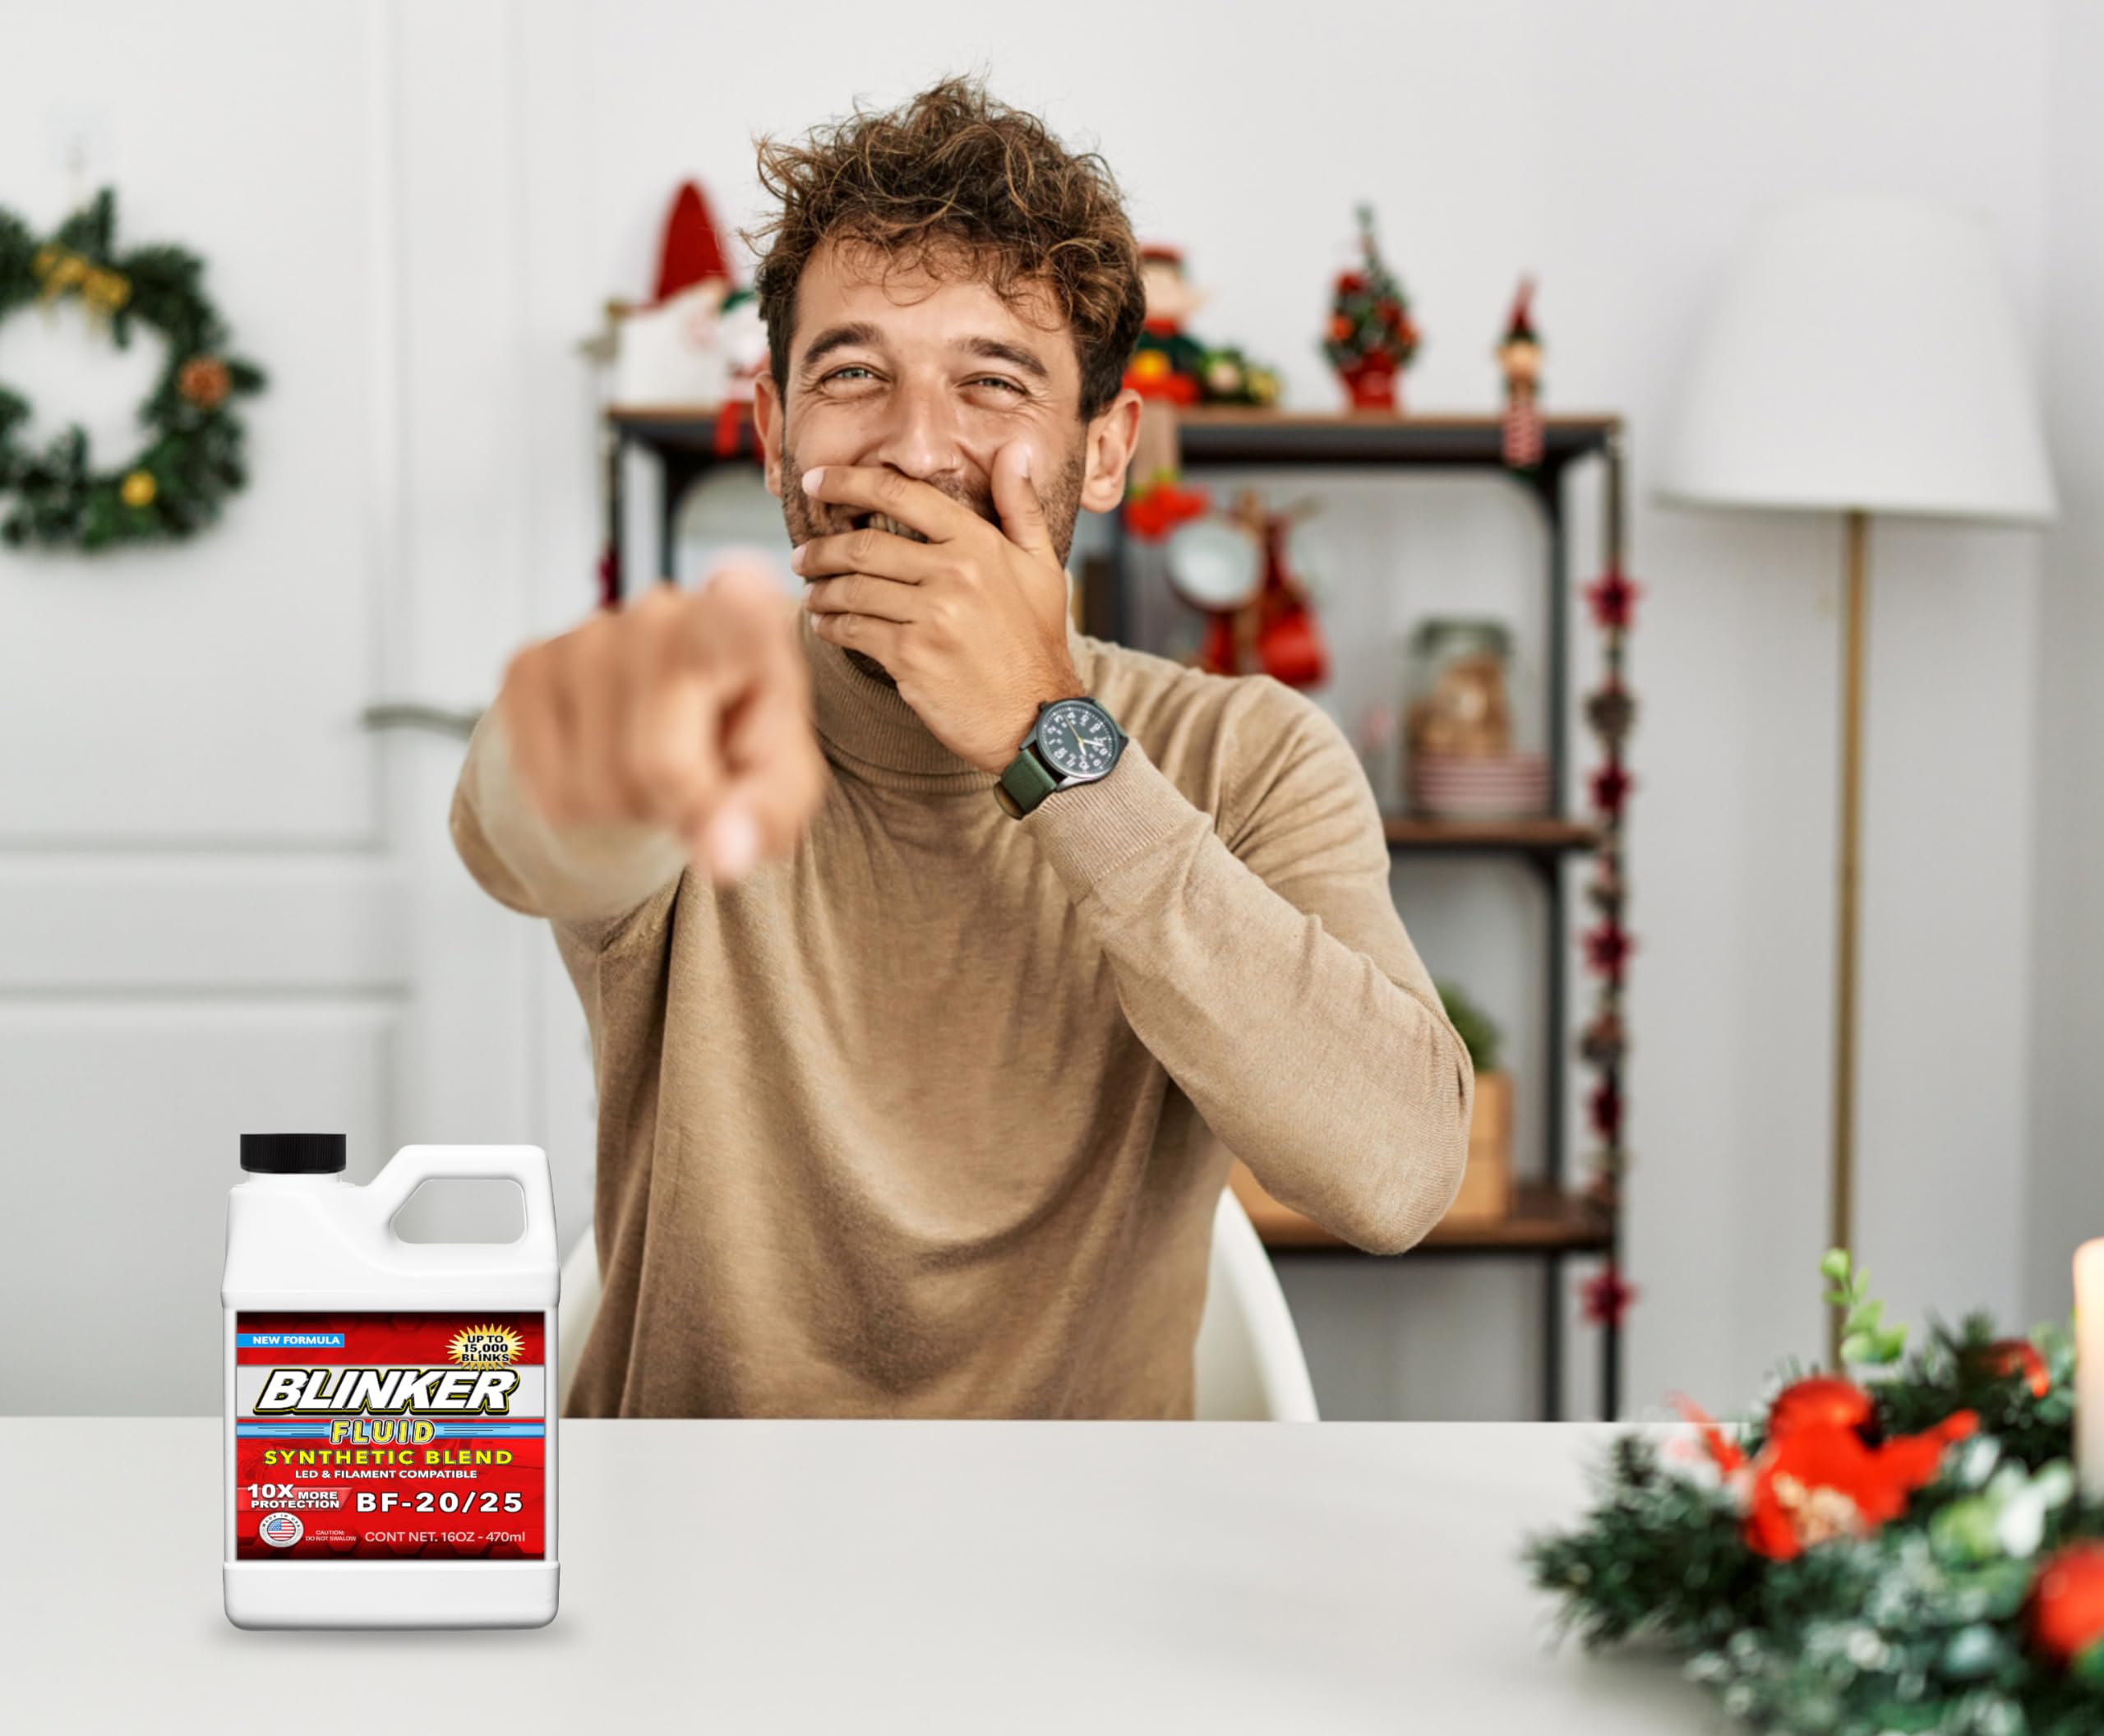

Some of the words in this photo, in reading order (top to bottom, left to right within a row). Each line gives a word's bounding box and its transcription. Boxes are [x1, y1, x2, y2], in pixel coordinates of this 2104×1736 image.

[252, 1336, 280, 1345] NEW
[283, 1336, 340, 1345] FORMULA
[467, 1335, 484, 1343] UP
[487, 1335, 504, 1343] TO
[463, 1344, 508, 1354] 15,000
[252, 1369, 519, 1415] BLINKER
[330, 1420, 436, 1444] FLUID
[263, 1450, 415, 1466] SYNTHETIC
[425, 1450, 514, 1466] BLEND
[295, 1470, 319, 1479] LED
[321, 1470, 331, 1479] &
[334, 1470, 397, 1479] FILAMENT
[399, 1470, 478, 1479] COMPATIBLE
[247, 1483, 294, 1499] 10X
[298, 1491, 338, 1500] MORE
[251, 1500, 339, 1508] PROTECTION
[356, 1491, 524, 1513] BF-20/25
[262, 1514, 277, 1527] MADE
[364, 1531, 406, 1542] CONT
[408, 1531, 438, 1542] NET.
[486, 1531, 526, 1542] 470ml
